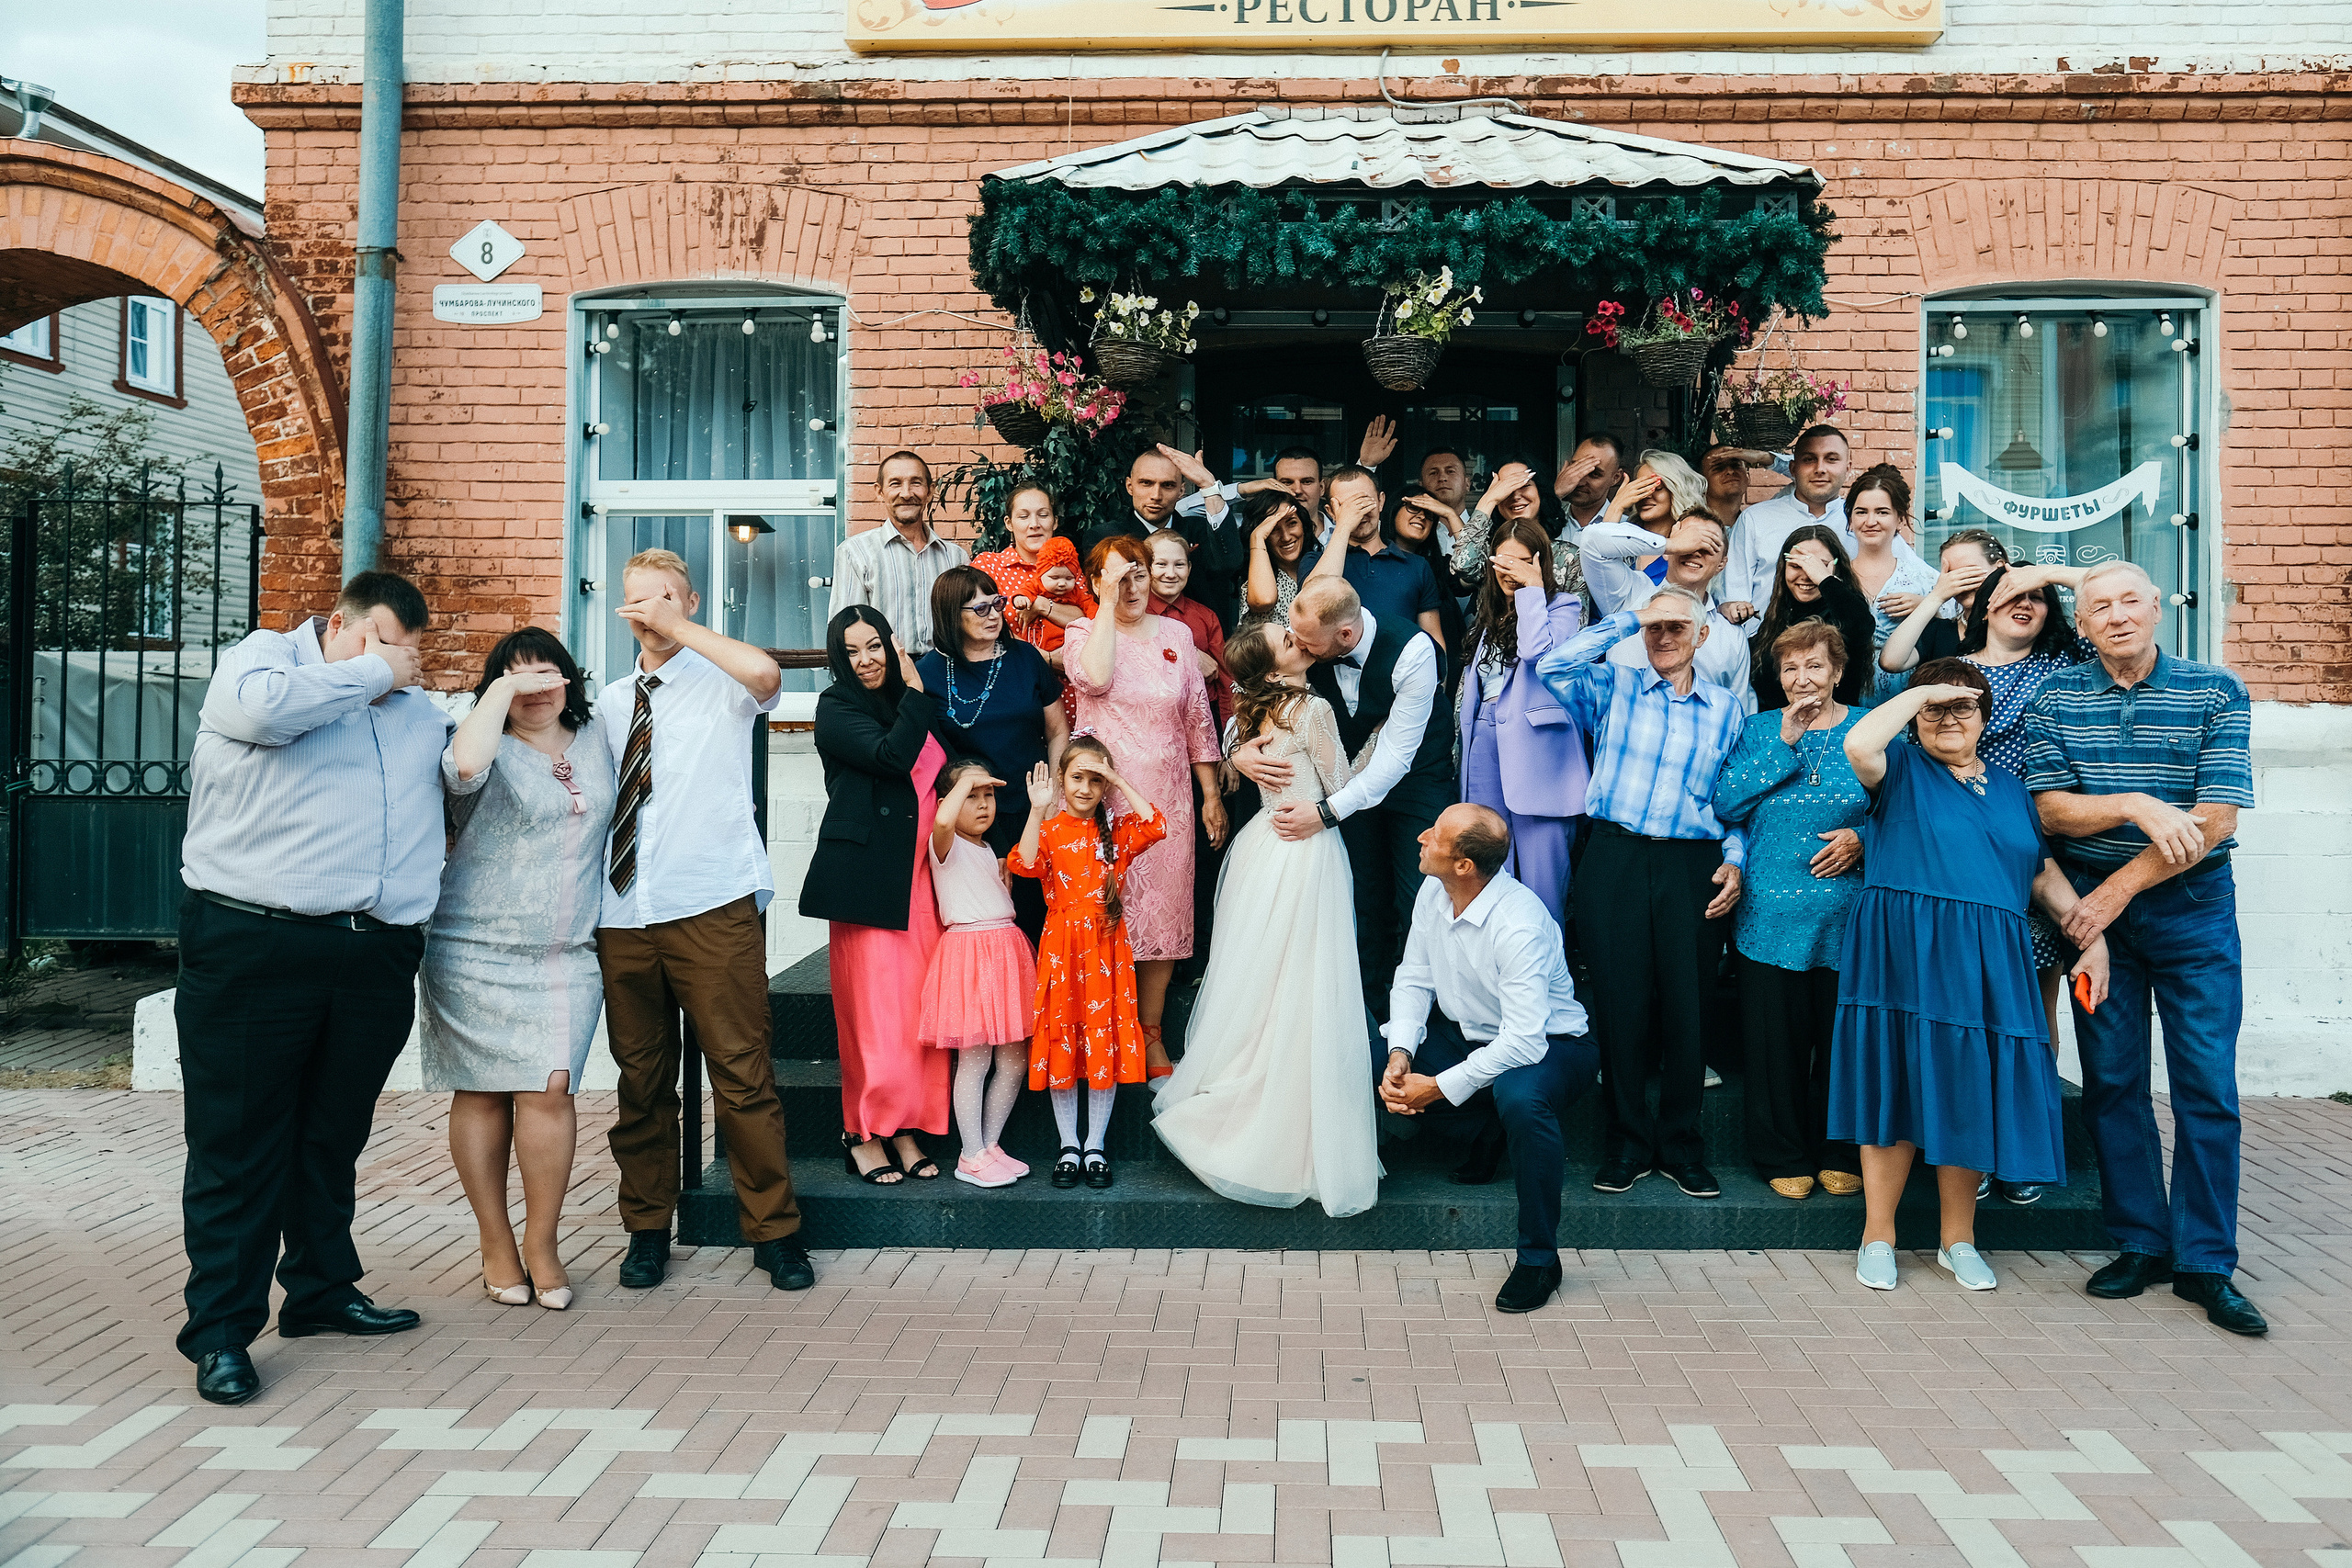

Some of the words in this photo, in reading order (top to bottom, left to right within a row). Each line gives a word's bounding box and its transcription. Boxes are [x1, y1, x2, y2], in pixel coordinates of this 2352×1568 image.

[481, 242, 493, 265] 8
[439, 299, 536, 308] ЧУМБАРОВА-ЛУЧИНСКОГО
[2003, 498, 2101, 522] ФУРШЕТЫ
